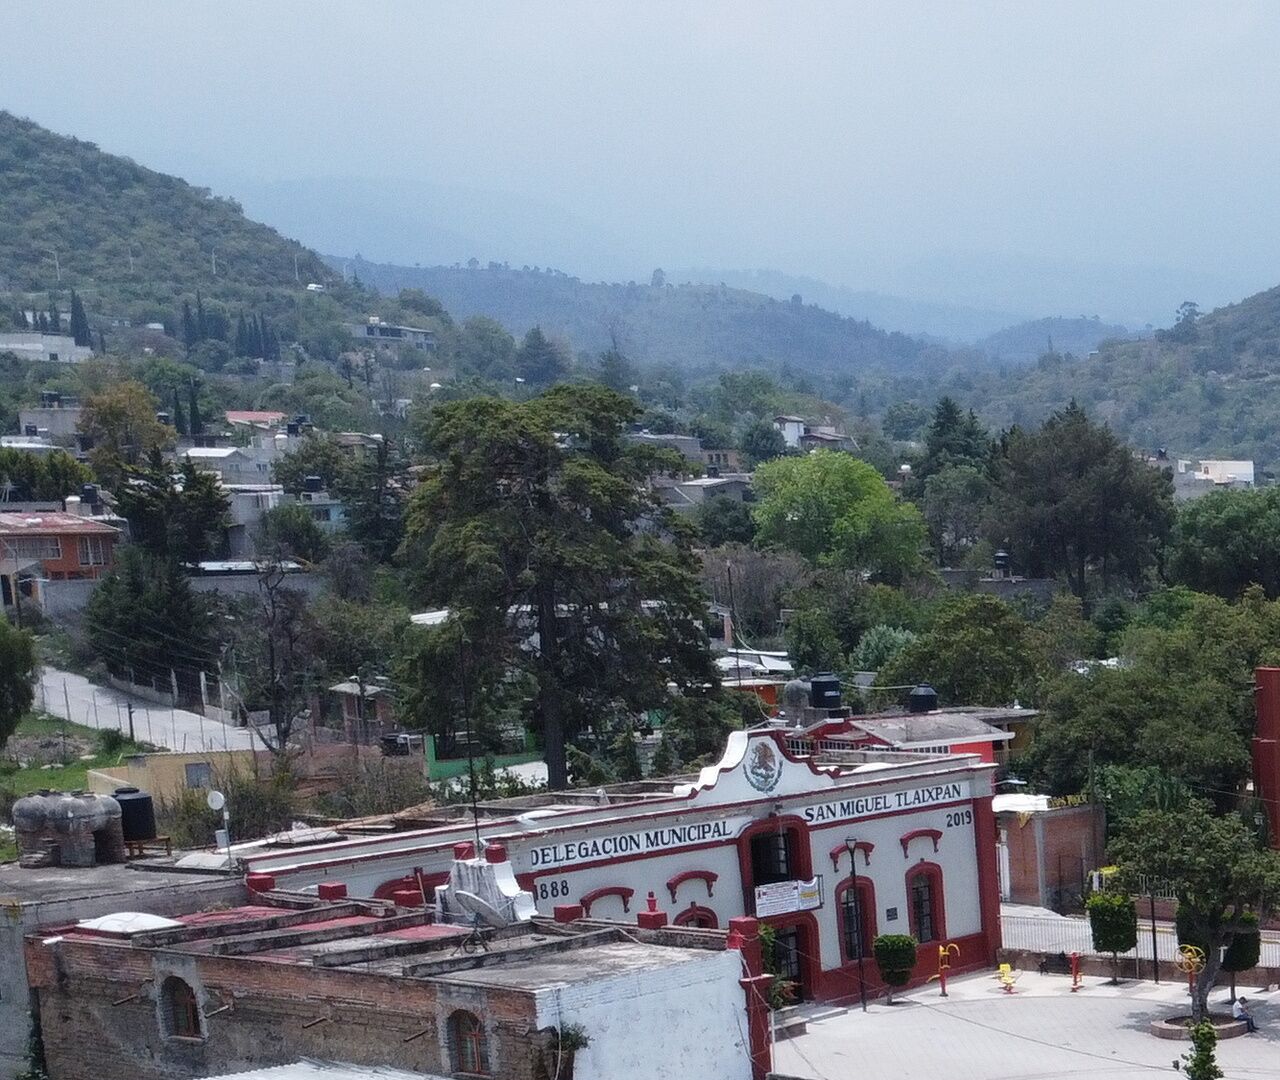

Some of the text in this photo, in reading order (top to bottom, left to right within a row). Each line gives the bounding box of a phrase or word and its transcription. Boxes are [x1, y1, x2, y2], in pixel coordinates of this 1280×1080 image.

[805, 783, 962, 823] SAN MIGUEL TLAIXPAN
[946, 810, 972, 828] 2019
[531, 821, 733, 865] DELEGACION MUNICIPAL
